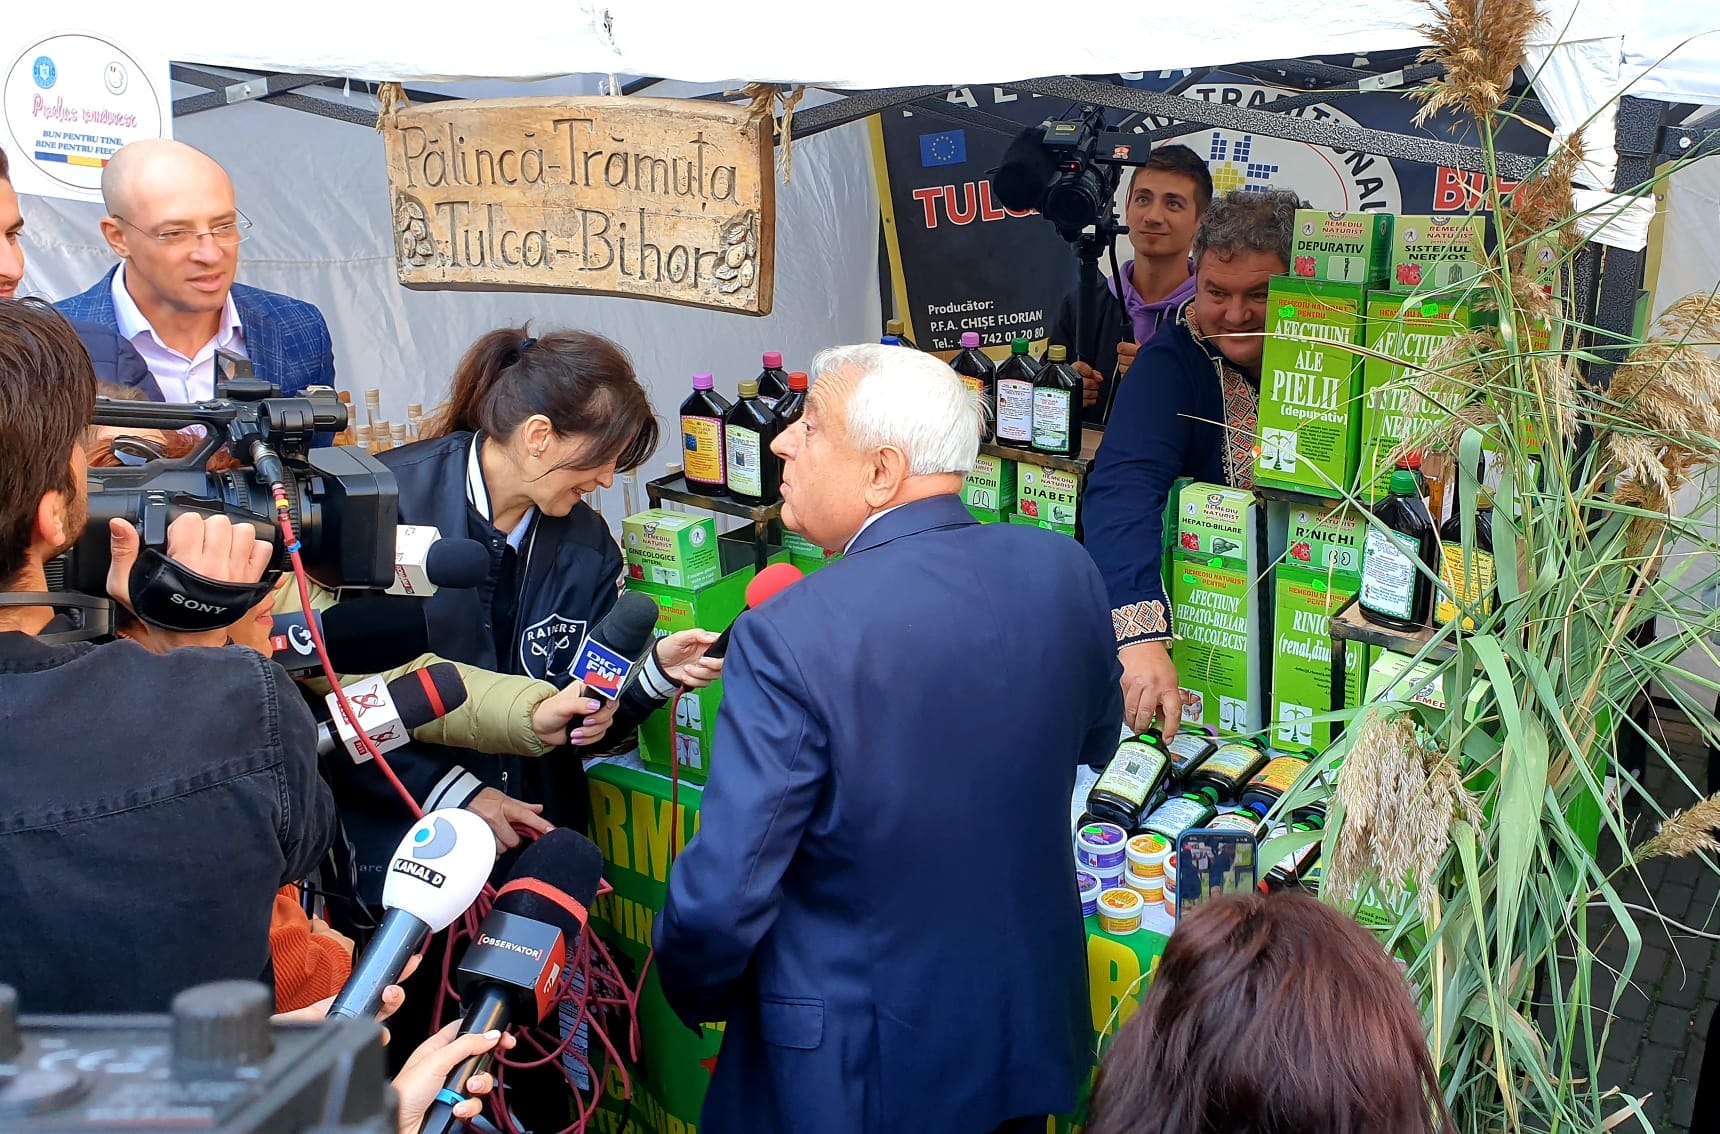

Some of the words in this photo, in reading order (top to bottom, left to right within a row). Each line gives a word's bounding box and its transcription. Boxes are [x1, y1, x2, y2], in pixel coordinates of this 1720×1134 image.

[43, 130, 62, 138] BUN
[63, 132, 99, 143] PENTRU
[35, 140, 57, 149] BINE
[58, 143, 94, 153] PENTRU
[95, 146, 116, 155] FIEC
[912, 180, 1040, 229] TUL
[1322, 227, 1364, 235] NATURIST
[434, 201, 727, 288] Tulca-Bihor
[1297, 240, 1364, 254] DEPURATIV
[927, 300, 995, 315] Producător:
[930, 320, 959, 333] P.F.A.
[998, 309, 1043, 325] FLORIAN
[932, 338, 955, 350] Tel.:
[1034, 326, 1044, 338] 80
[1295, 350, 1323, 372] ALE
[1271, 369, 1340, 410] PIELII
[1023, 486, 1075, 503] DIABET
[1203, 509, 1240, 520] NATURIST
[1182, 517, 1242, 534] HEPATO-BILIARE
[628, 547, 676, 562] GINECOLOGICE
[170, 593, 228, 614] SONY
[585, 659, 615, 682] FM
[586, 650, 622, 675] DIGI
[393, 859, 431, 881] KANAL
[431, 872, 443, 885] D
